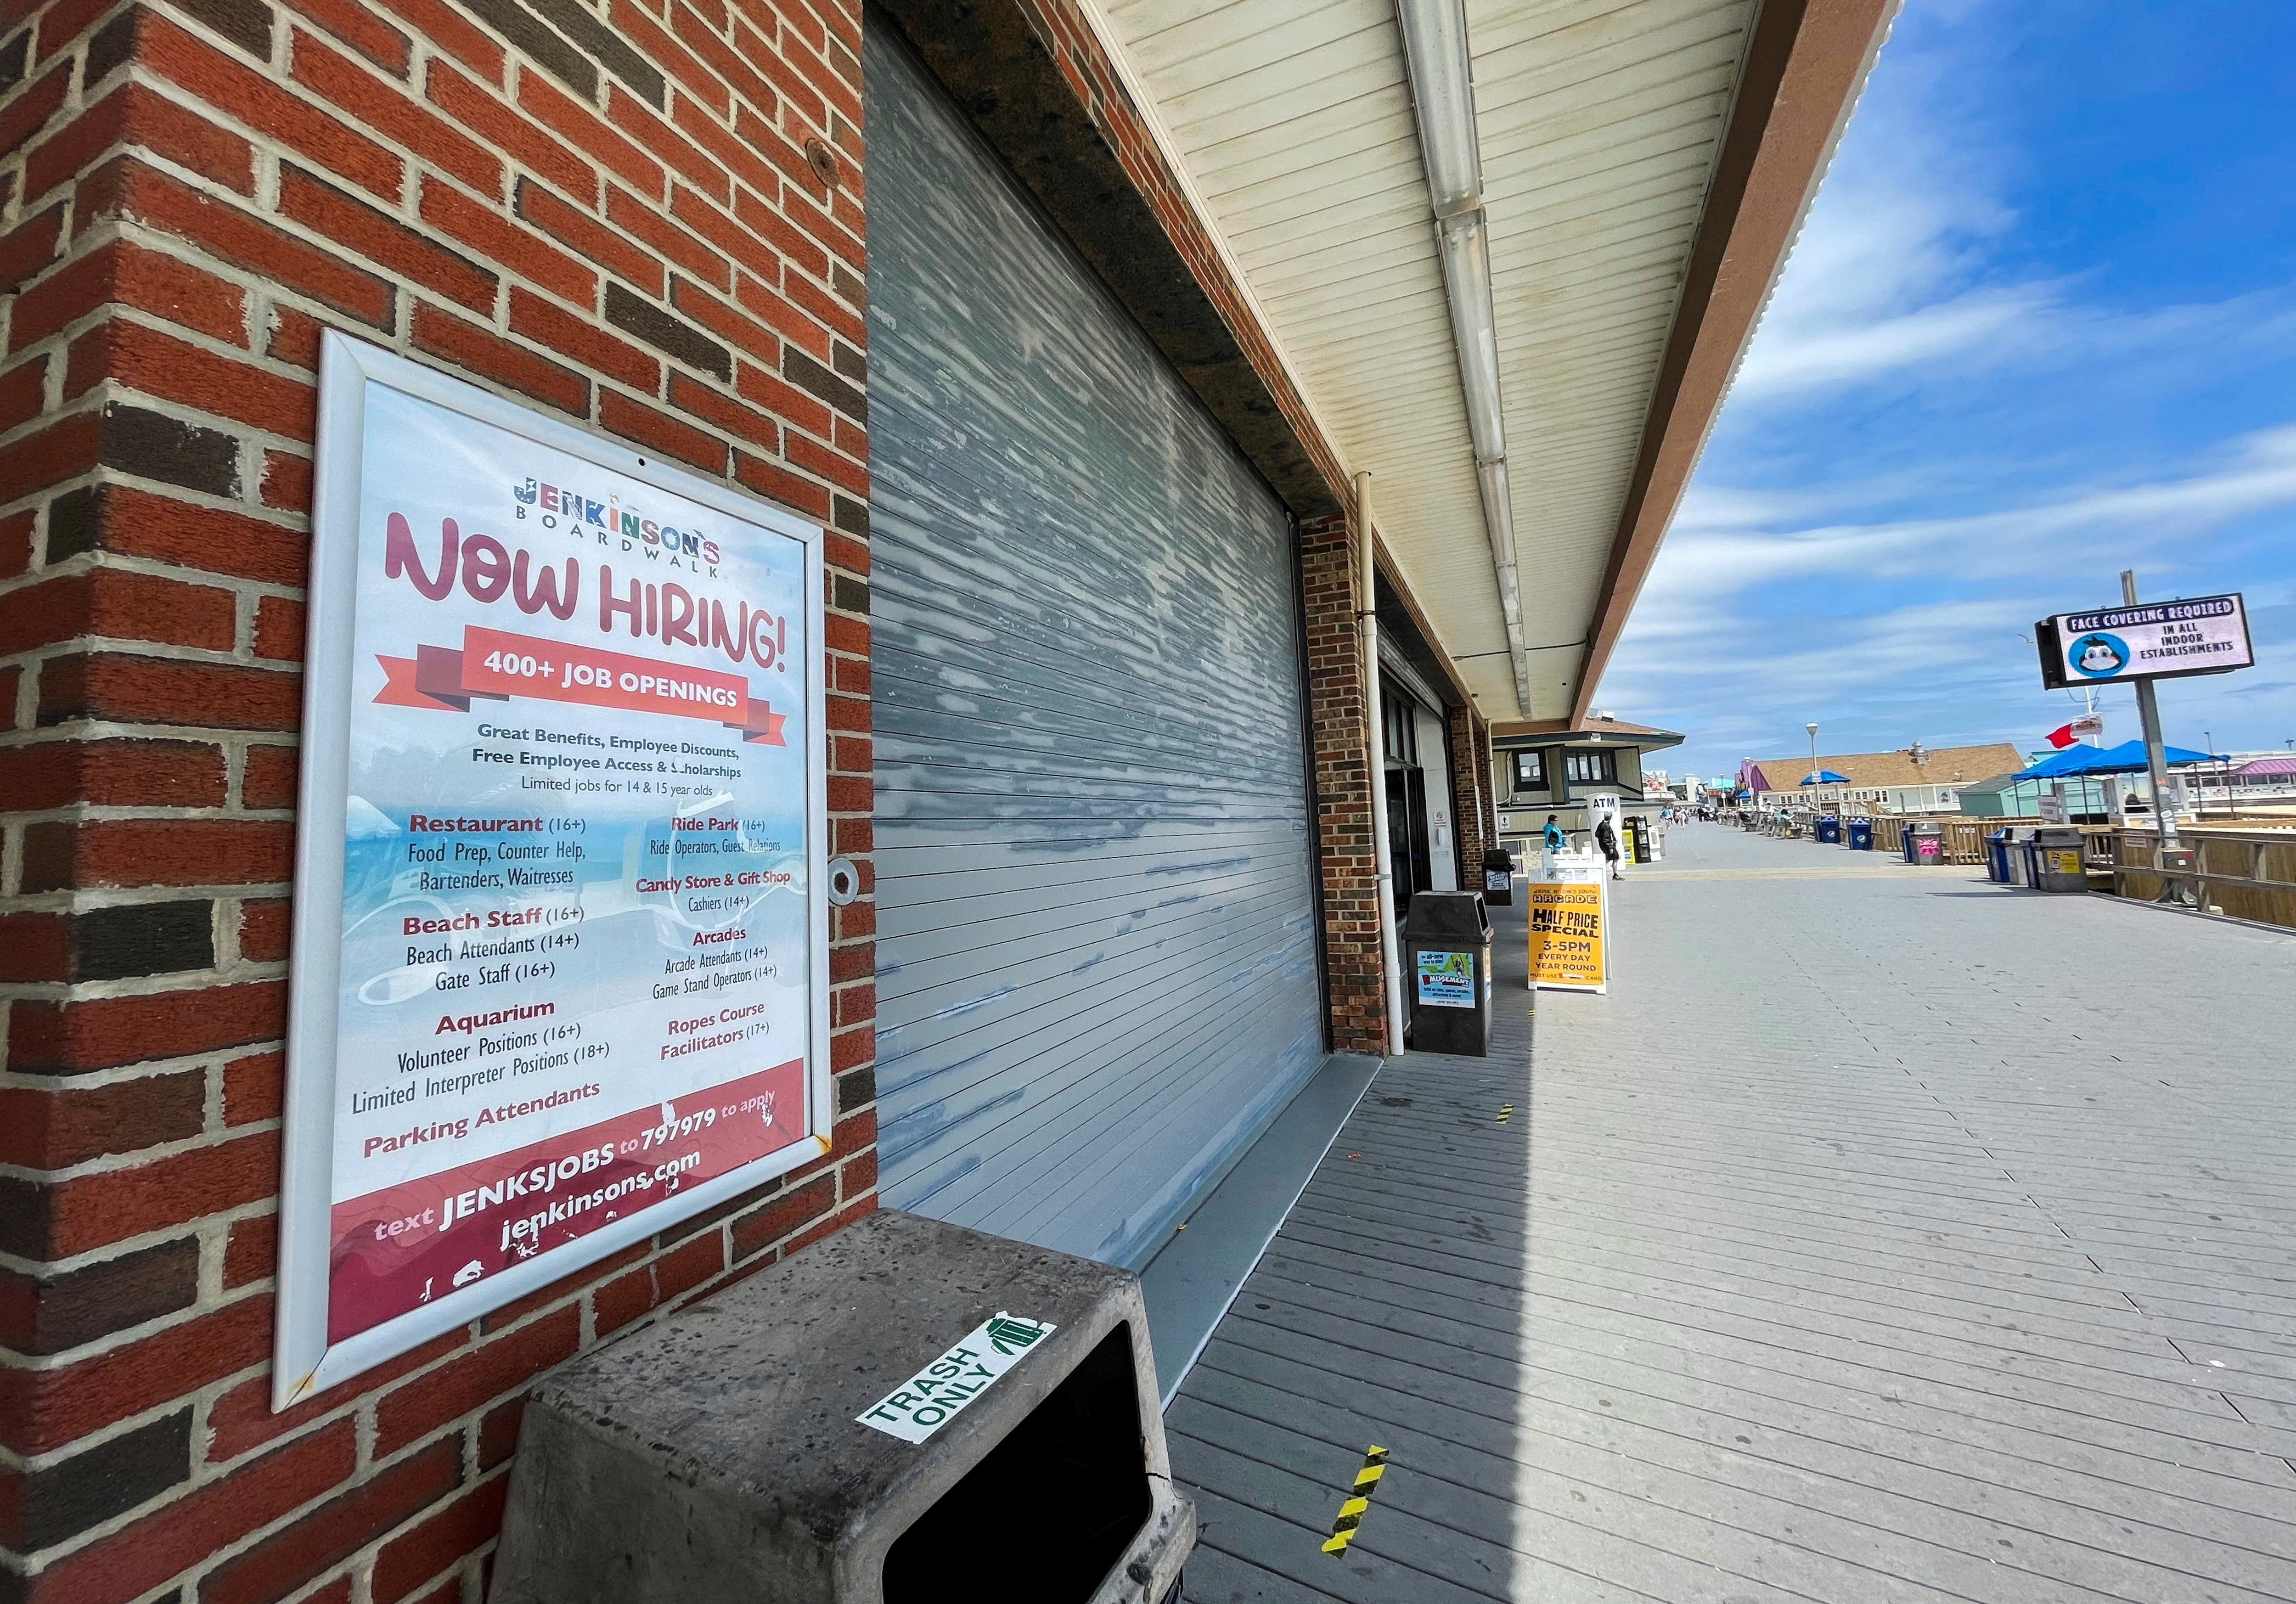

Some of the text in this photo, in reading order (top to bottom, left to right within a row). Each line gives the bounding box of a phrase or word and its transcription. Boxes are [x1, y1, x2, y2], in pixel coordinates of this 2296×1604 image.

[514, 477, 720, 564] JENKINSON'S
[516, 505, 717, 578] BOARDWALK
[385, 512, 786, 673] NOW HIRING!
[2071, 601, 2231, 630] FACE COVERING REQUIRED
[2163, 623, 2198, 635] IN ALL
[2140, 641, 2234, 659] ESTABLISHMENTS
[2161, 633, 2203, 646] INDOOR
[484, 651, 738, 708] 400+ JOB OPENINGS
[478, 724, 739, 760] Great Benefits, Employee Discounts,
[473, 748, 514, 764] Free
[520, 751, 600, 771] Employee
[604, 758, 653, 772] Access
[657, 761, 667, 772] &
[522, 776, 713, 797] Limited jobs for 14 & 15 year olds
[1593, 798, 1615, 809] ATM
[409, 814, 586, 834] Restaurant (16+)
[671, 817, 765, 833] Ride Park (16+)
[408, 841, 586, 866] Food Prep, Counter Help,
[650, 838, 780, 859] Ride Operators, Guest Relations
[420, 867, 574, 891] Bartenders, Waitresses
[636, 871, 790, 894] Candy Store & Gift Shop
[688, 895, 749, 912] Cashiers (14+)
[1533, 894, 1597, 904] ARCADE
[403, 906, 585, 935] Beach Staff (16+)
[1531, 923, 1598, 938] SPECIAL
[1533, 908, 1598, 929] HALF PRICE
[407, 933, 580, 966] Beach Attendants (14+)
[692, 928, 747, 946] Arcades
[1543, 940, 1590, 952] 3-5PM
[664, 946, 768, 974] Arcade Attendants (14+)
[435, 961, 555, 991] Gate Staff (16+)
[653, 964, 777, 1000] Game Stand Operators (14+)
[435, 1002, 555, 1035] Aquarium
[668, 1003, 765, 1035] Ropes Course
[398, 1022, 581, 1073] Volunteer Positions (16+)
[660, 1021, 769, 1060] Facilitators (17+)
[352, 1041, 610, 1114] Limited Interpreter Positions (18+)
[364, 1082, 600, 1158] Parking Attendants
[374, 1090, 776, 1241] text JENKSJOBS to 797979 to apply
[500, 1150, 700, 1251] jenkinsons.com
[866, 1347, 980, 1422] TRASH
[912, 1362, 996, 1425] ONLY
